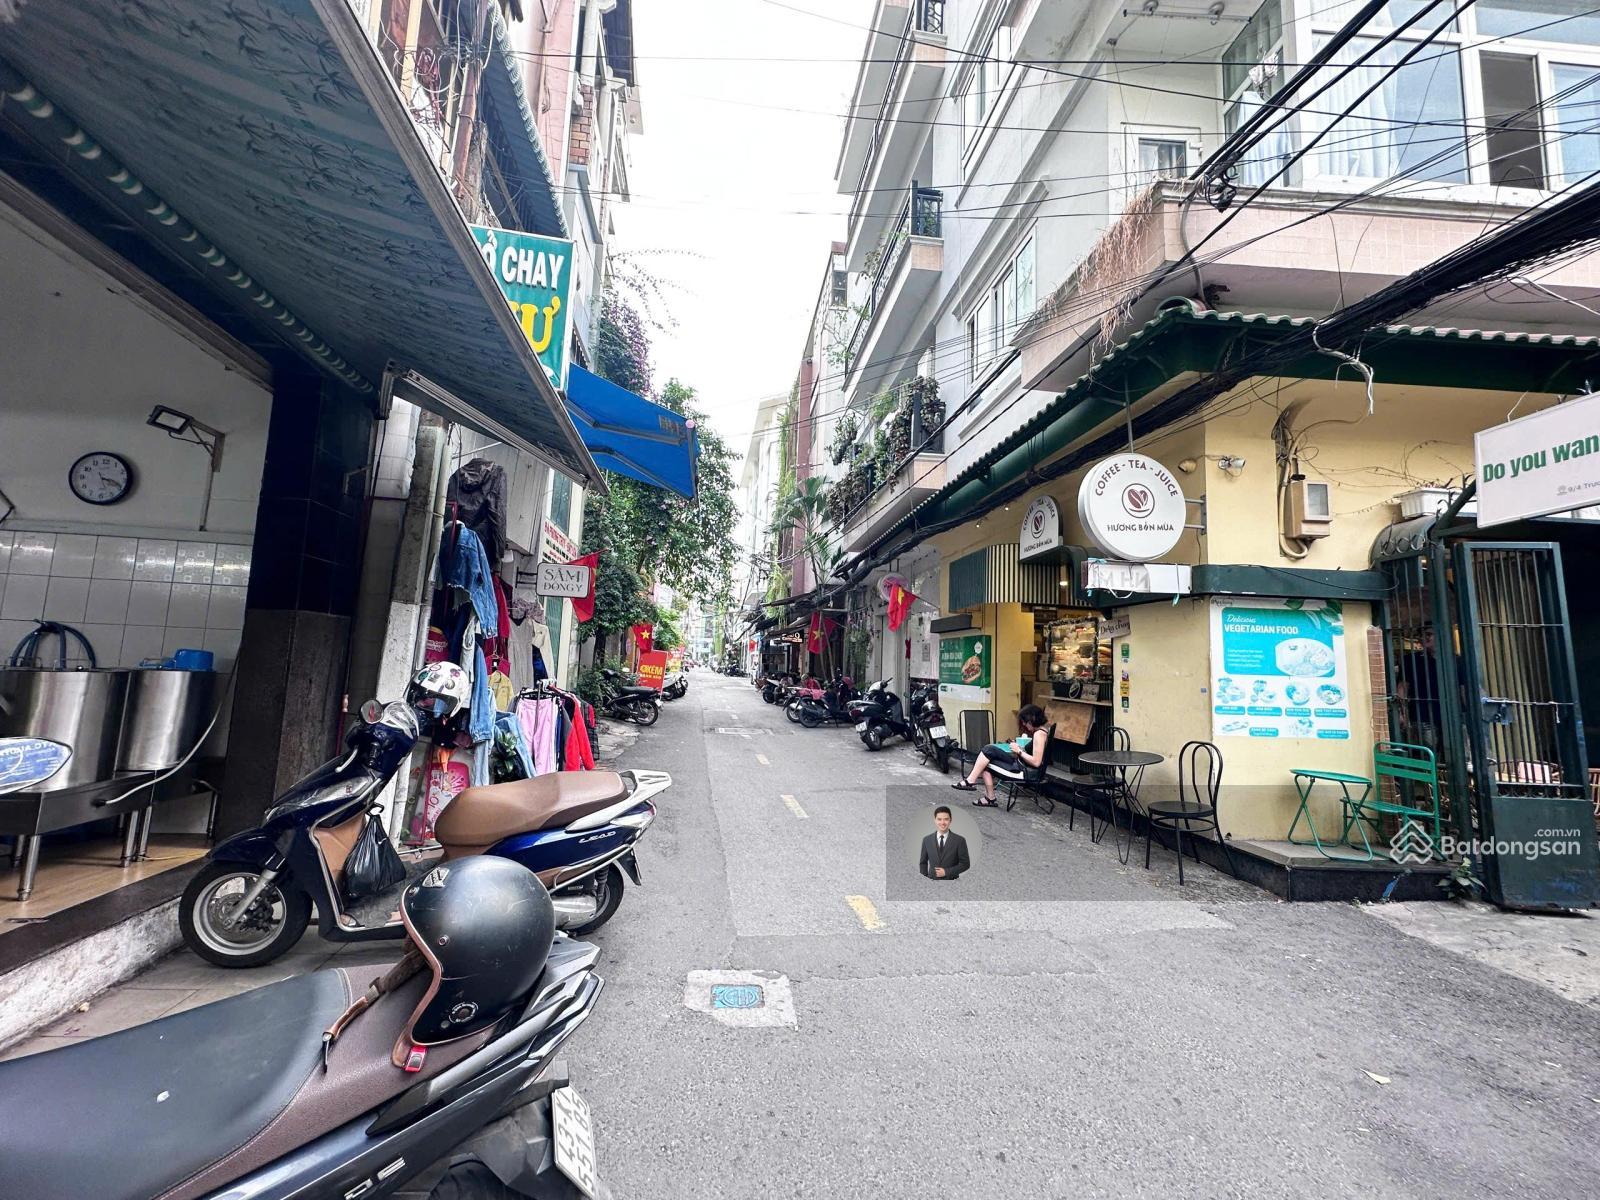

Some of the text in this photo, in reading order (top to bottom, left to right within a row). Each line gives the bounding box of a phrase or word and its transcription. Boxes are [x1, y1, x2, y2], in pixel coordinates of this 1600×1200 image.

[502, 246, 564, 290] CHAY
[1483, 435, 1600, 482] Do you wan
[1096, 463, 1121, 496] COFFEE
[1128, 460, 1146, 470] TEA
[1155, 470, 1178, 496] JUICE
[1224, 624, 1298, 634] VEGETARIAN FOOD
[579, 831, 616, 843] LEAD
